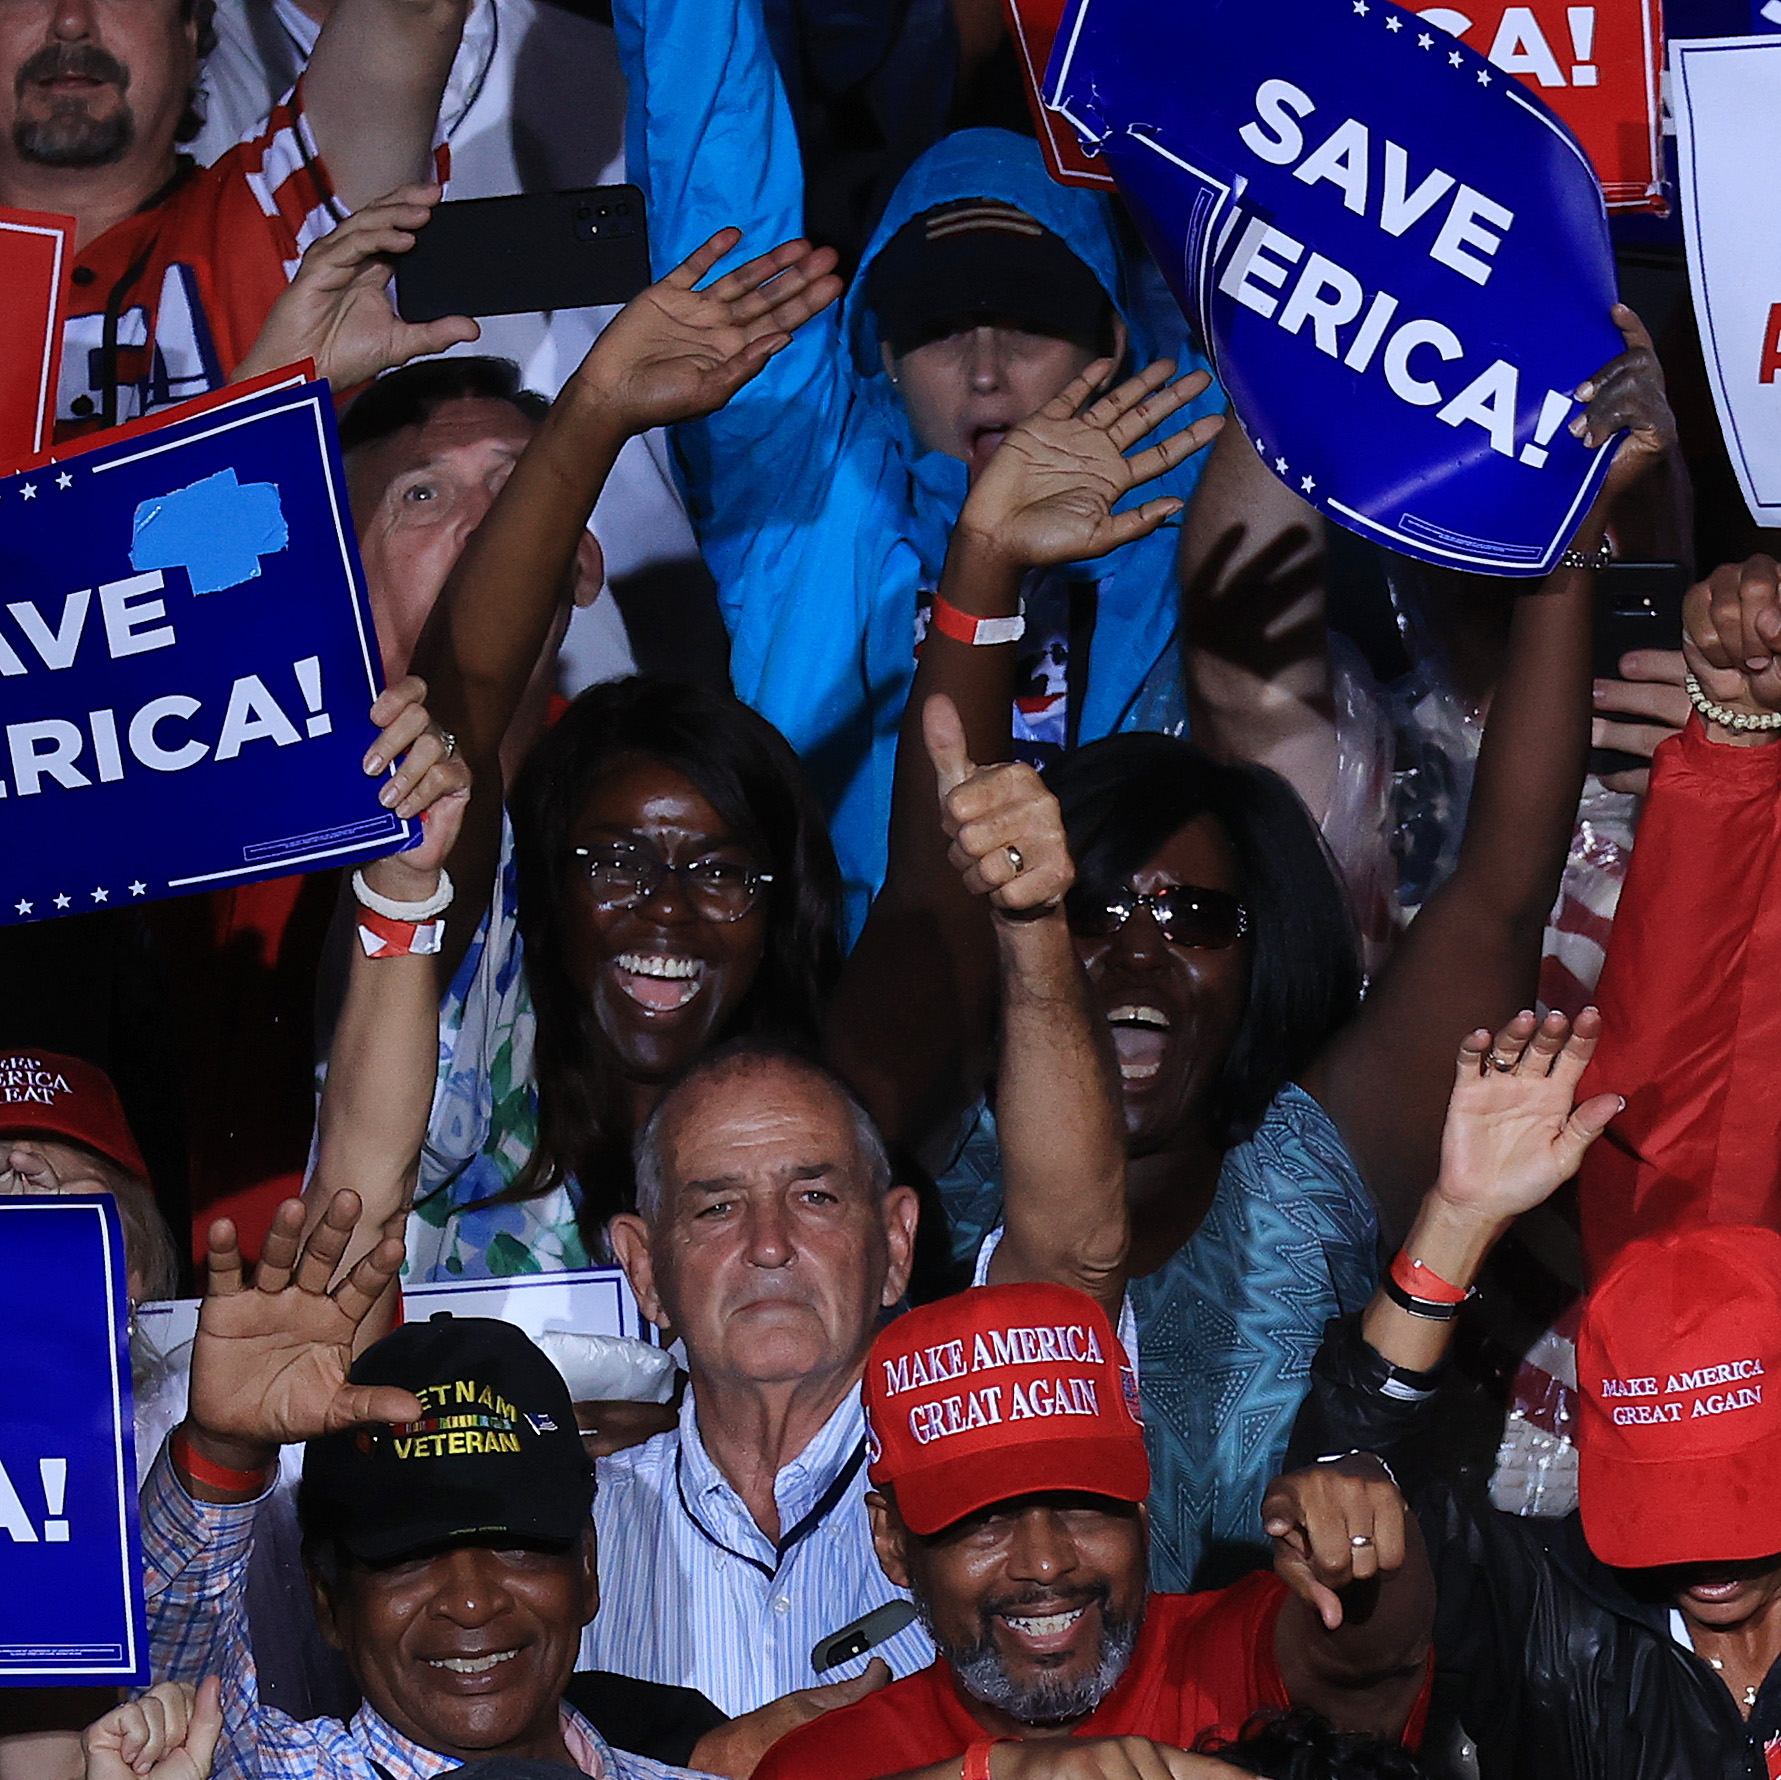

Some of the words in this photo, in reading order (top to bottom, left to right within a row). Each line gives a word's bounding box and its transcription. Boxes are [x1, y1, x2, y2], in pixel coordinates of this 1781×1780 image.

[1239, 78, 1515, 285] SAVE
[0, 655, 333, 802] RICA!
[883, 1338, 968, 1398] MAKE
[971, 1324, 1105, 1374] AMERICA
[1601, 1376, 1659, 1398] MAKE
[1664, 1358, 1765, 1394] AMERICA
[908, 1385, 1004, 1446] GREAT
[1009, 1377, 1100, 1422] AGAIN
[1613, 1402, 1684, 1426] GREAT
[1690, 1385, 1763, 1419] AGAIN
[393, 1431, 521, 1460] VETERAN
